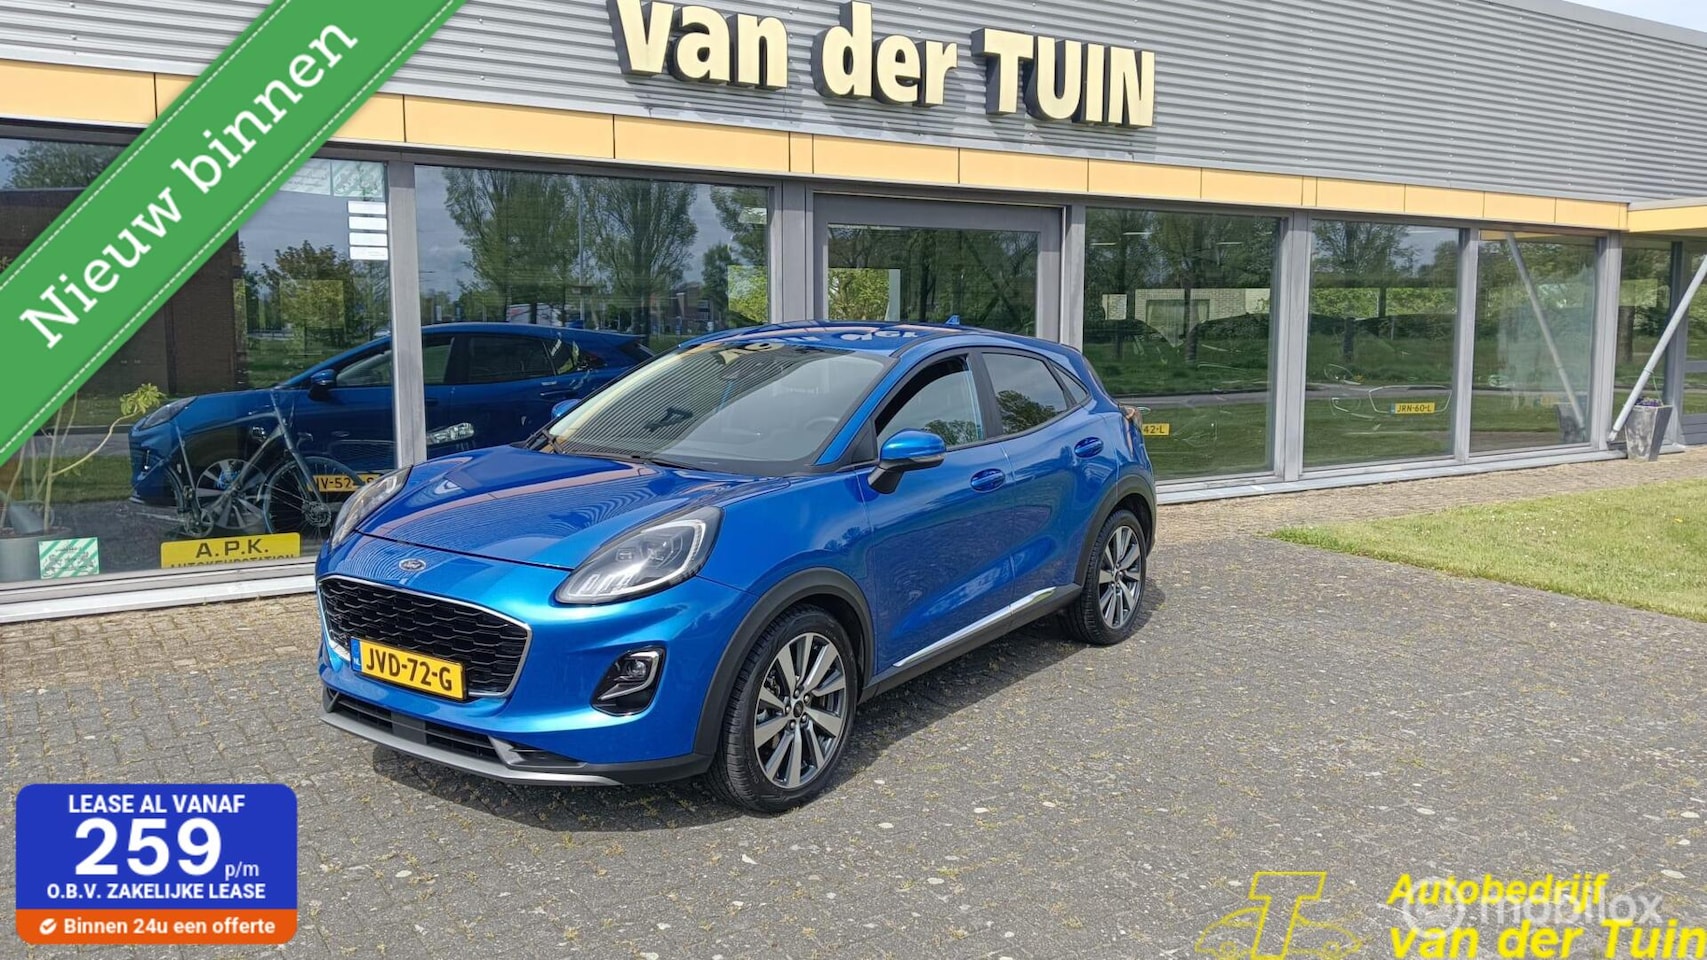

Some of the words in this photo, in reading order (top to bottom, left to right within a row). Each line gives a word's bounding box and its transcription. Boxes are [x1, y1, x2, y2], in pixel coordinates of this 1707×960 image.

[616, 0, 787, 88] van
[821, 0, 957, 105] der
[983, 28, 1155, 128] TUIN
[195, 539, 269, 558] A.P.K.
[366, 648, 453, 692] JVD-72-G
